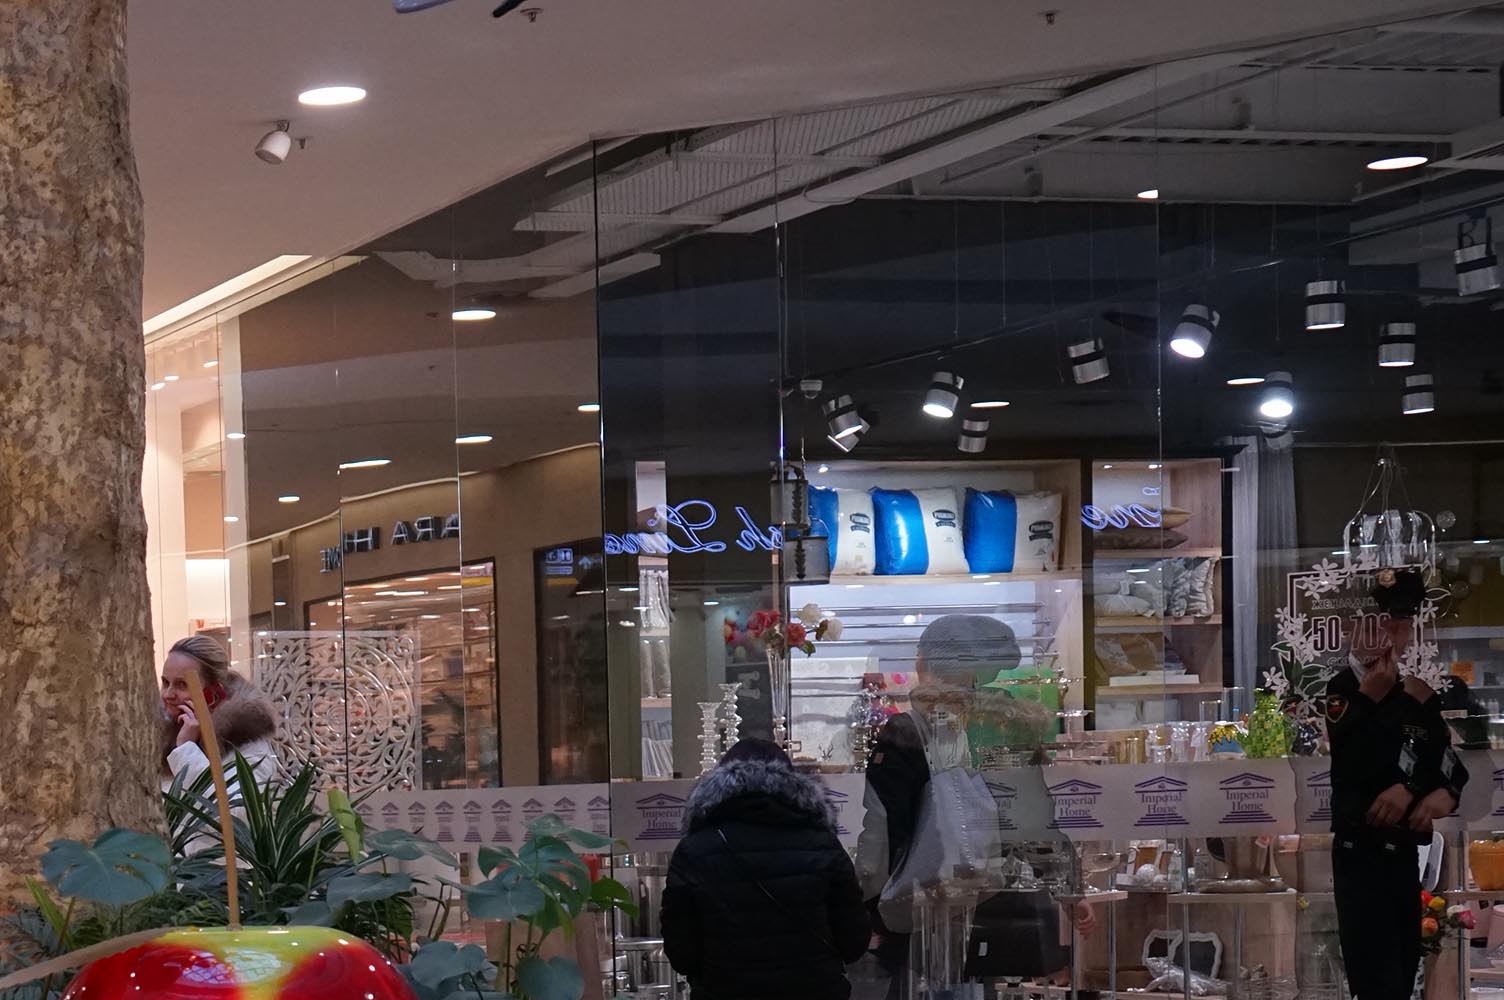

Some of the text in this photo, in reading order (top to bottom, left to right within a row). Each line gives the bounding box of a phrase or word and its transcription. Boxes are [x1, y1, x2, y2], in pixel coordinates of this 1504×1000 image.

[1227, 789, 1269, 801] Imperial
[1055, 795, 1097, 807] Imperial
[1233, 801, 1263, 811] Home
[1060, 807, 1091, 817] Home
